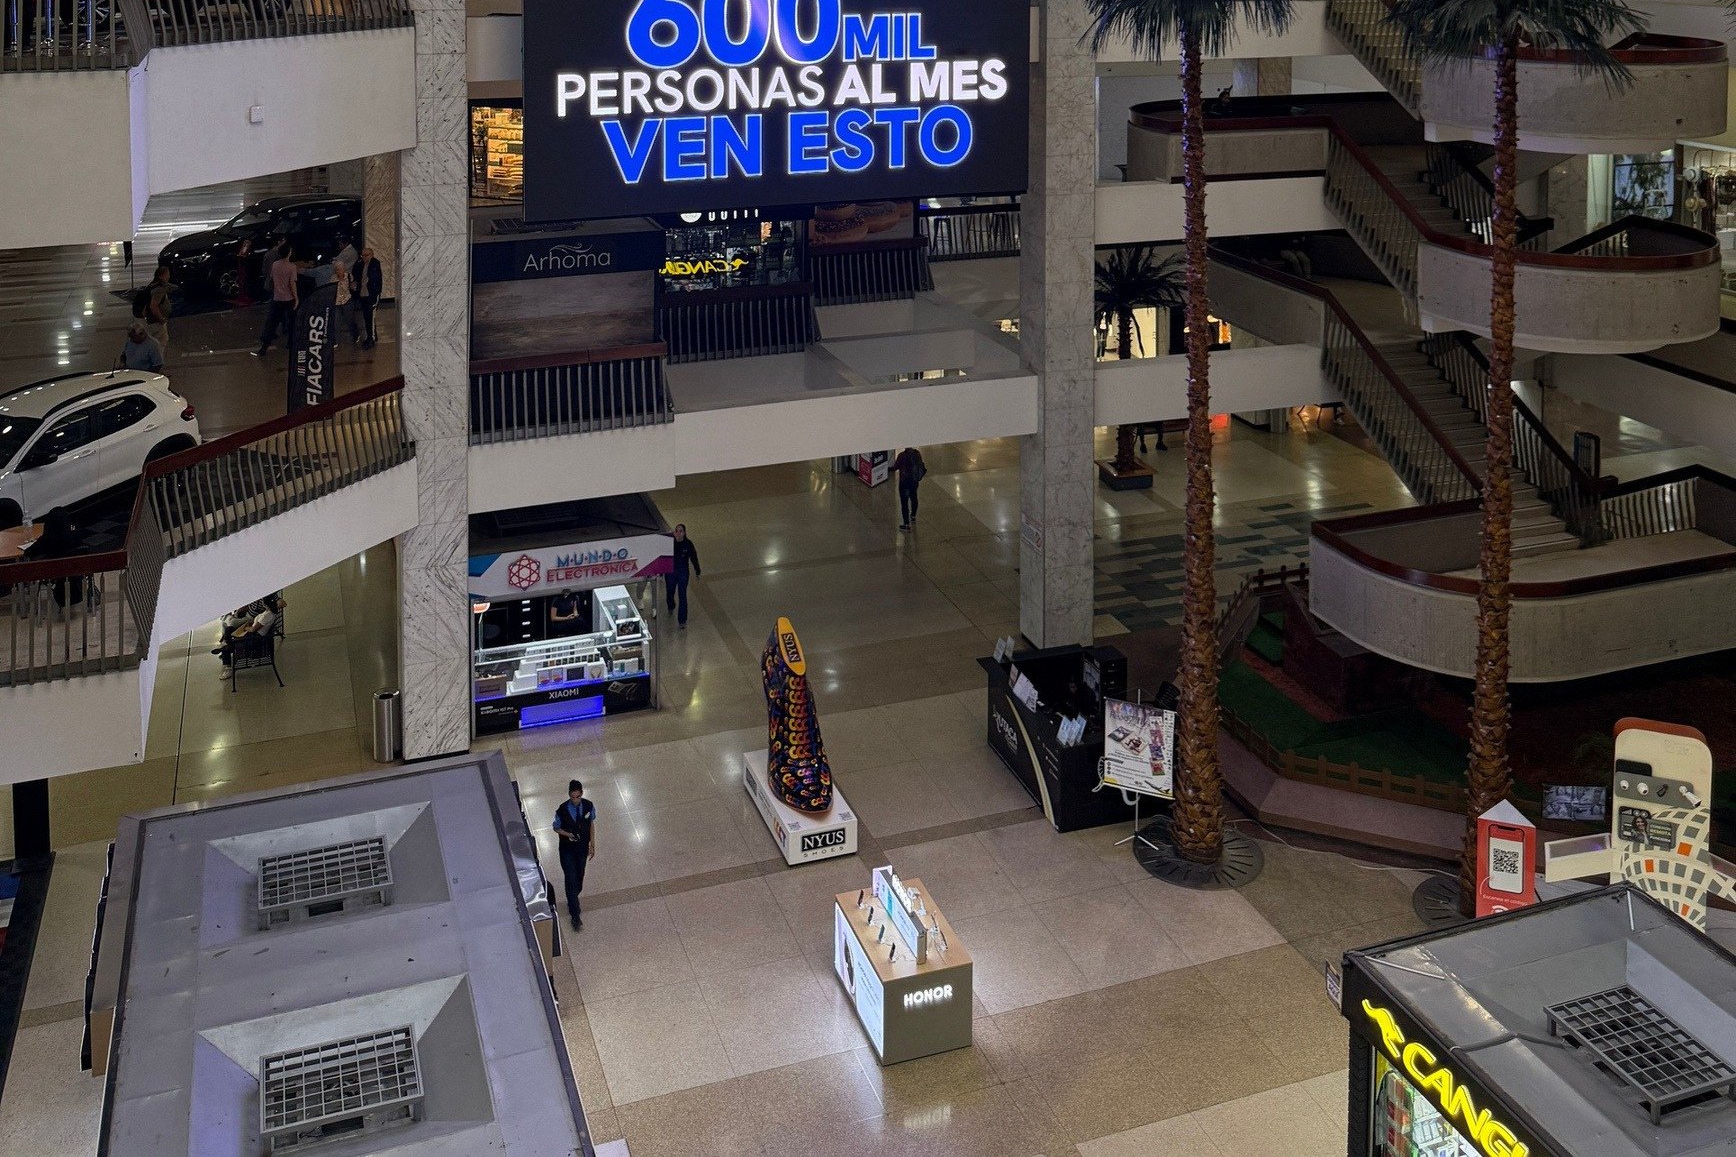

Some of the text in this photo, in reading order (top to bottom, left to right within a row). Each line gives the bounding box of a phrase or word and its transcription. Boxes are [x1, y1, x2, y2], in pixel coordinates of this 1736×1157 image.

[842, 11, 938, 63] MIL
[556, 59, 1009, 119] PERSONAS AL MES
[600, 103, 975, 185] VEN ESTO
[523, 251, 611, 272] Arhoma
[306, 315, 325, 406] FIACARS
[783, 633, 800, 662] NYUS
[549, 688, 579, 700] XIAOMI
[803, 830, 845, 850] NYUS
[803, 846, 844, 858] SHOES
[903, 984, 953, 1005] HONOR
[1403, 1042, 1530, 1157] CANG
